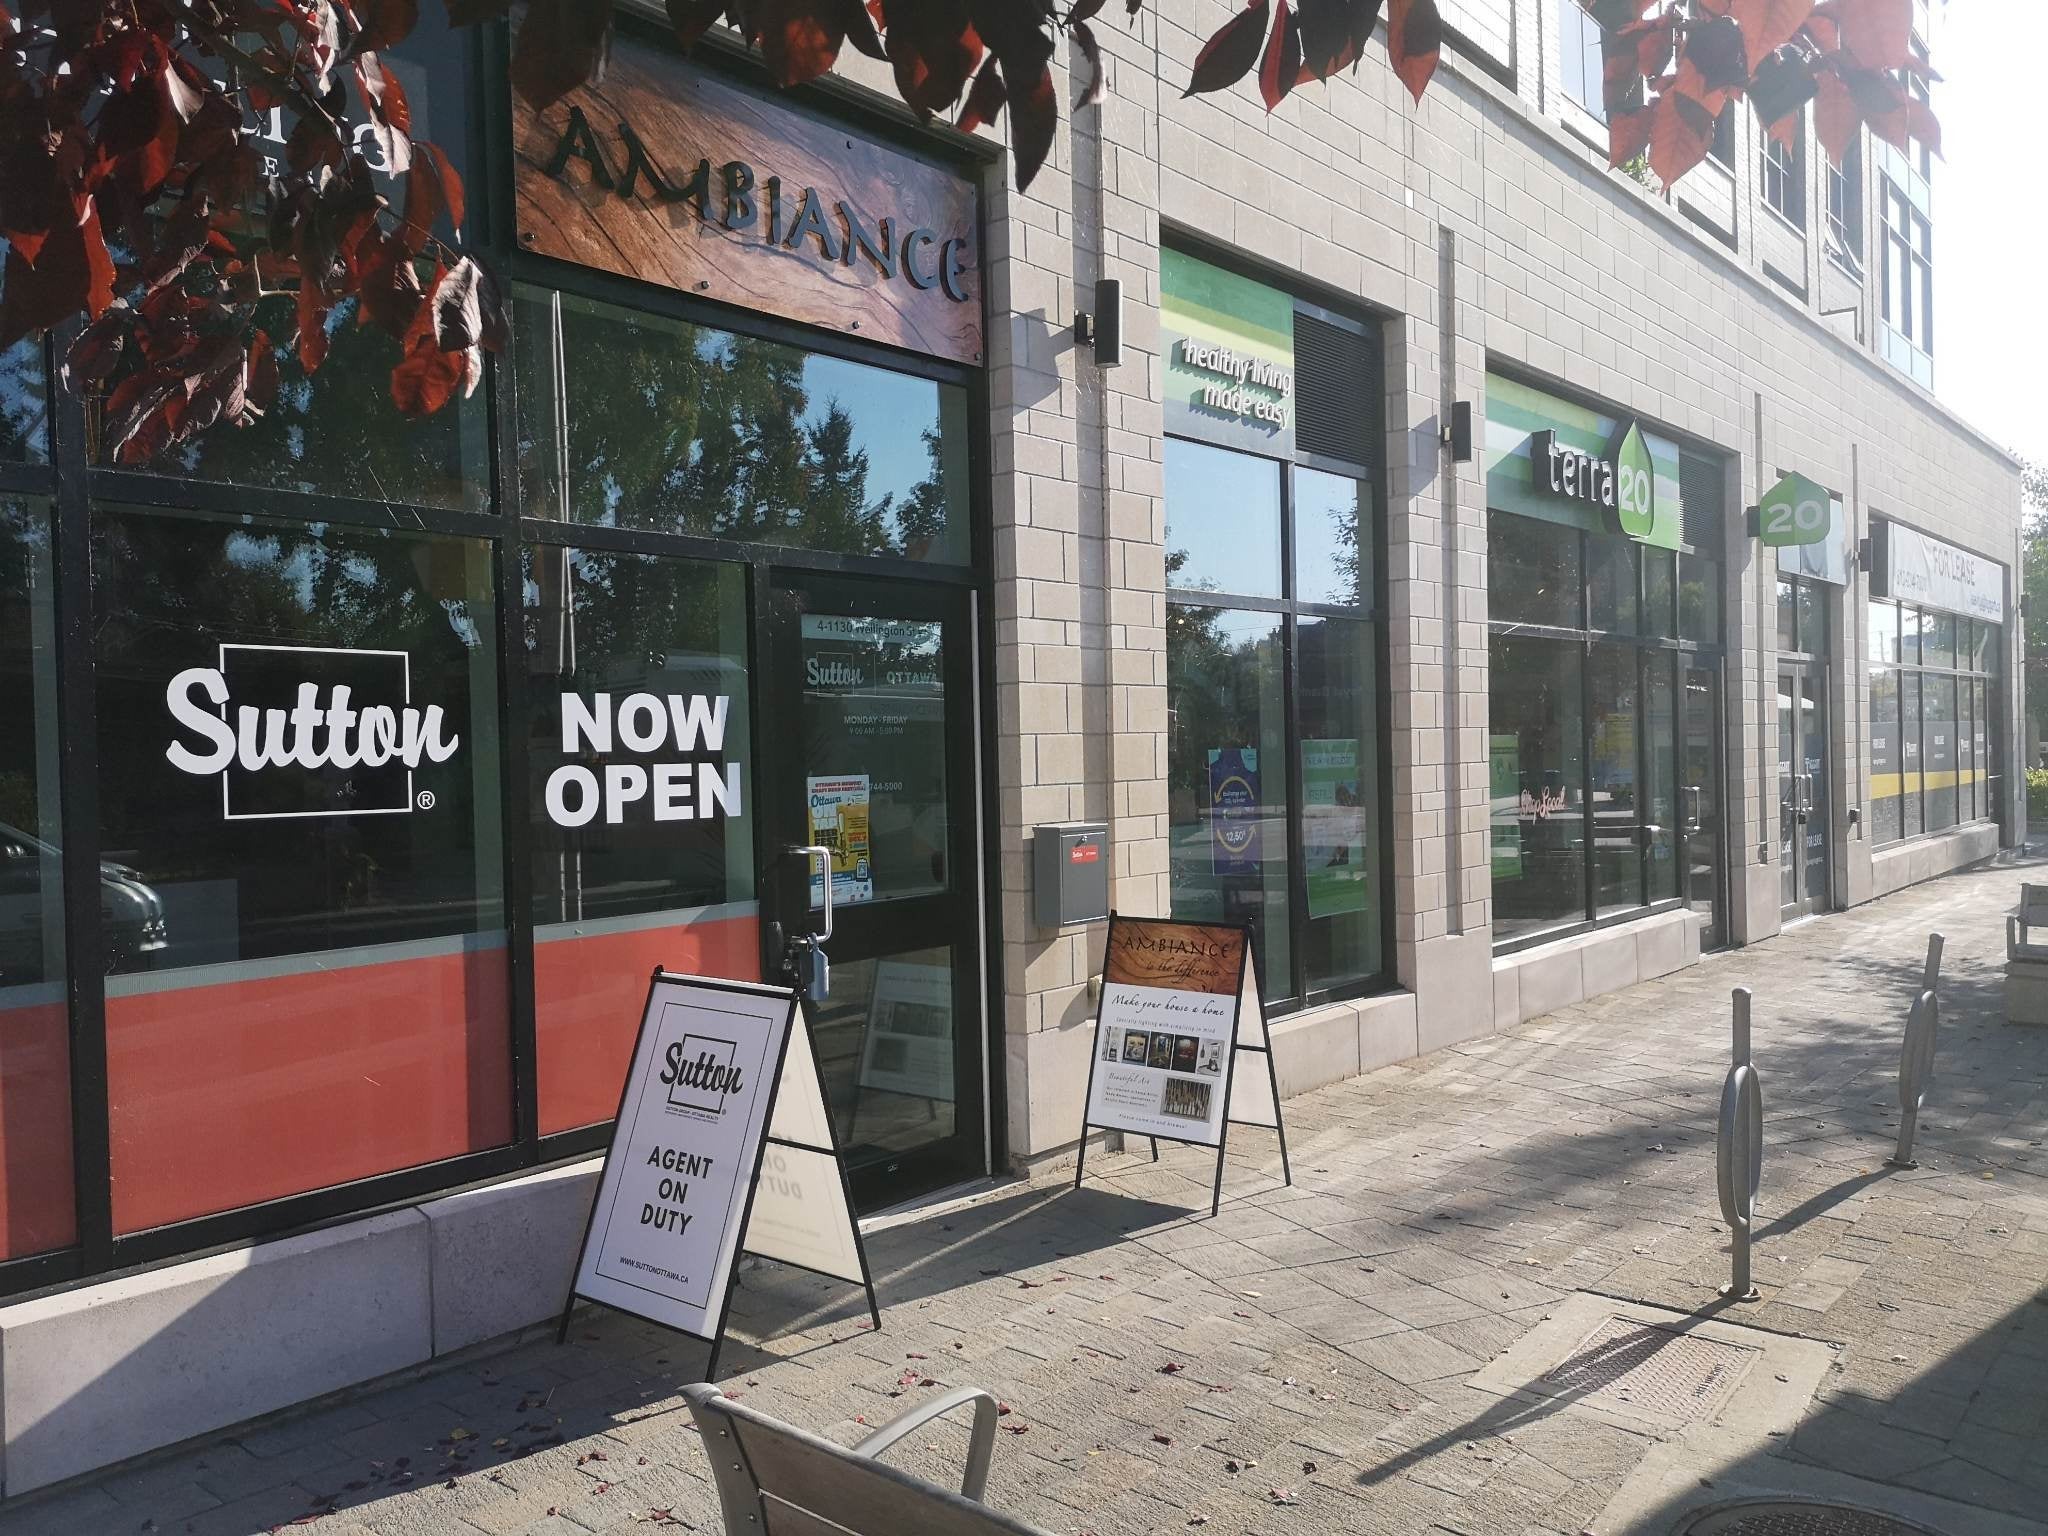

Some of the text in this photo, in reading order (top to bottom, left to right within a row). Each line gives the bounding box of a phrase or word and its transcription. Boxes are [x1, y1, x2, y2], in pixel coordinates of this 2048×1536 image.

[555, 106, 968, 302] AMBIANCE
[1182, 337, 1293, 397] healthy living
[1204, 385, 1292, 430] made easy
[1549, 428, 1650, 516] terra 20
[1767, 500, 1823, 533] 20
[1931, 545, 1951, 578] FOR
[1951, 553, 1976, 586] LEASE
[817, 621, 853, 633] 4-1130
[855, 623, 905, 639] Wellington
[807, 657, 938, 686] Sutton OTTAWA
[166, 667, 460, 775] Sutton
[561, 692, 730, 753] NOW
[844, 715, 878, 725] MONDAY
[882, 715, 909, 725] FRIDAY
[544, 762, 742, 828] OPEN
[811, 794, 842, 807] Ottawa
[1122, 936, 1231, 958] AMBIANCE
[1158, 957, 1175, 972] the
[1171, 957, 1220, 984] difference
[1112, 993, 1140, 1006] Make
[1136, 1001, 1162, 1013] your
[1164, 996, 1189, 1013] house
[1201, 1000, 1225, 1016] home
[660, 1042, 743, 1094] Sutton
[647, 1146, 713, 1179] AGENT
[658, 1178, 688, 1204] ON
[640, 1203, 693, 1236] DUTY
[619, 1256, 689, 1285] WWW.SUTTONOTTAWA.CA
